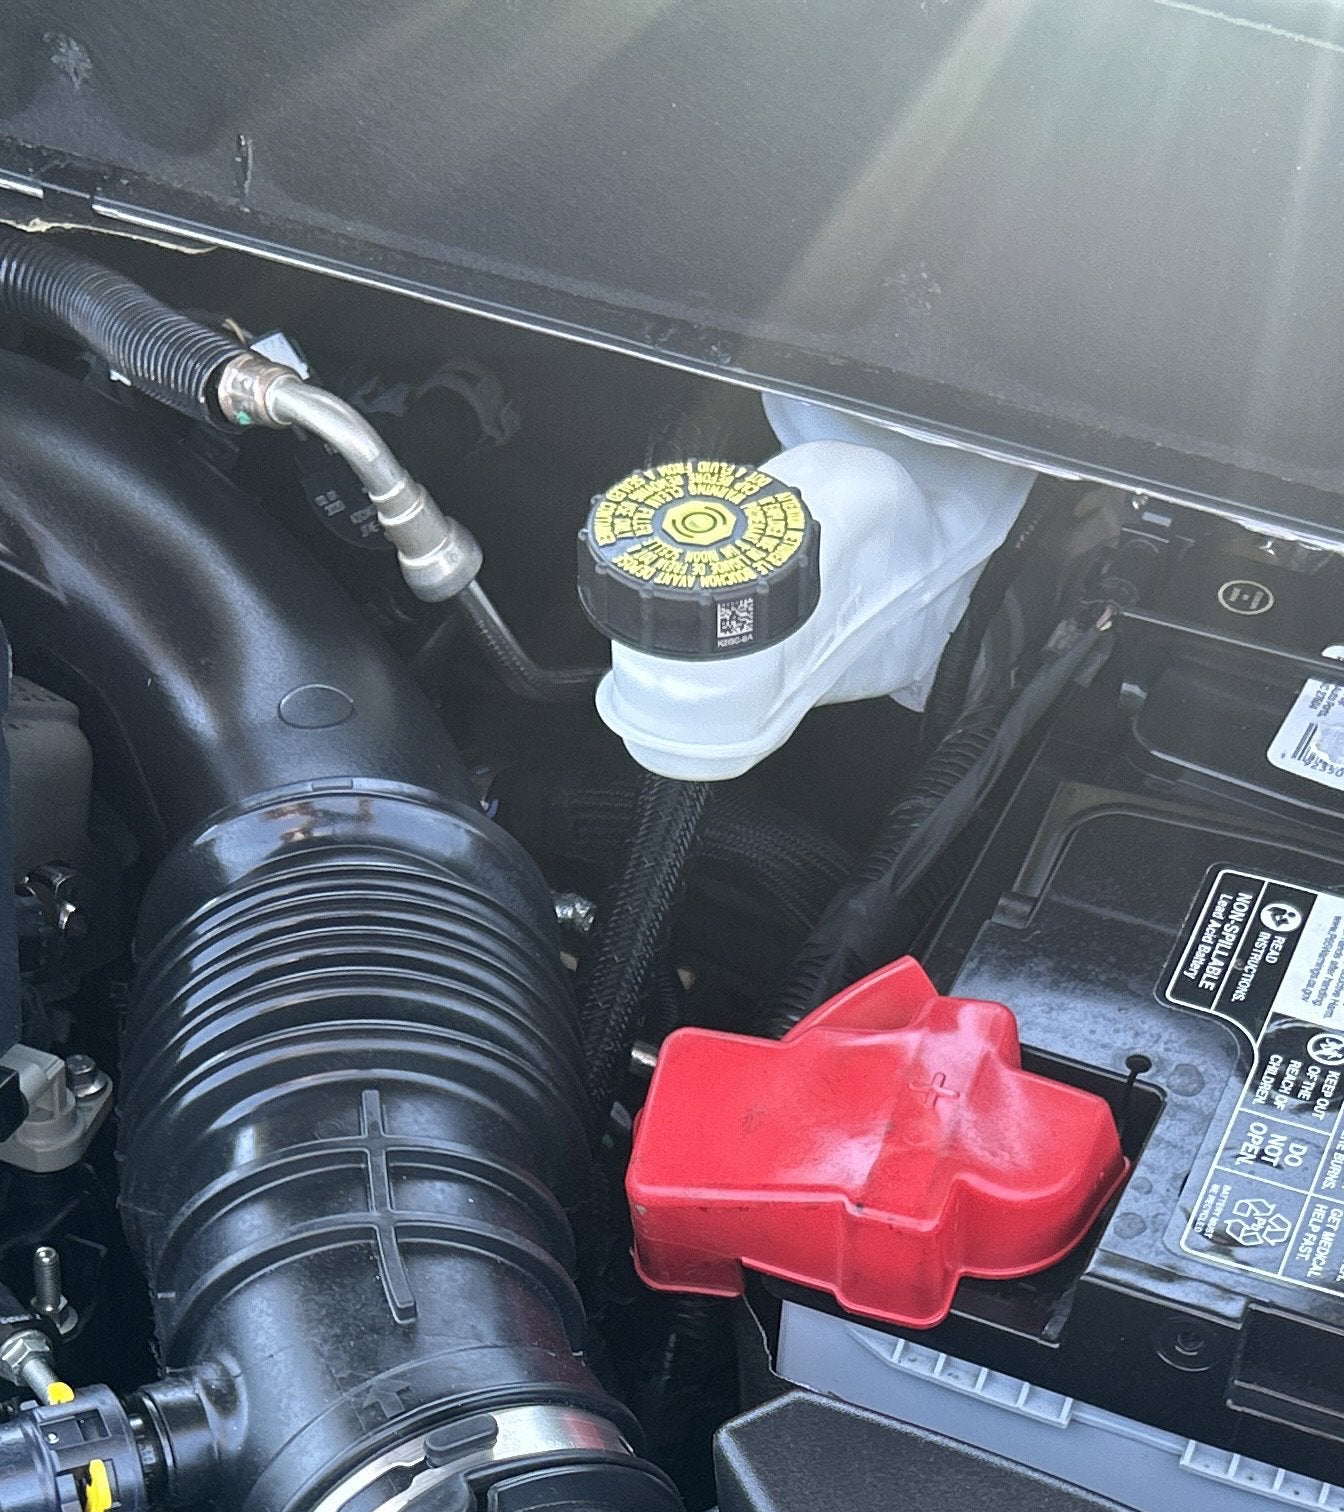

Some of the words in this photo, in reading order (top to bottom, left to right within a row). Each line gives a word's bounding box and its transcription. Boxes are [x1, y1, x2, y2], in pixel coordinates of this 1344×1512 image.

[653, 460, 693, 477] FROM
[697, 460, 737, 475] FLUID
[685, 483, 751, 504] WARNING
[1210, 892, 1233, 920] Lead
[1197, 890, 1253, 992] NON-SPILLABLE
[1199, 918, 1221, 946] Acid
[1181, 942, 1210, 980] Battery
[1263, 934, 1286, 965] READ
[1229, 929, 1271, 1005] INSTRUCTIONS.
[1251, 1053, 1283, 1107] CHILDREN.
[1277, 1058, 1302, 1096] REACH
[1304, 1063, 1320, 1080] OF
[1318, 1069, 1340, 1098] KEEP
[1270, 1093, 1288, 1111] OF
[1295, 1077, 1315, 1101] THE
[1309, 1096, 1329, 1121] OUT
[1234, 1119, 1268, 1168] OPEN.
[1259, 1132, 1287, 1166] NOT
[1282, 1141, 1308, 1168] DO
[1305, 1202, 1327, 1233] HELP
[1323, 1206, 1343, 1231] GET
[1294, 1231, 1316, 1262] FAST.
[1305, 1230, 1335, 1280] MEDICAL
